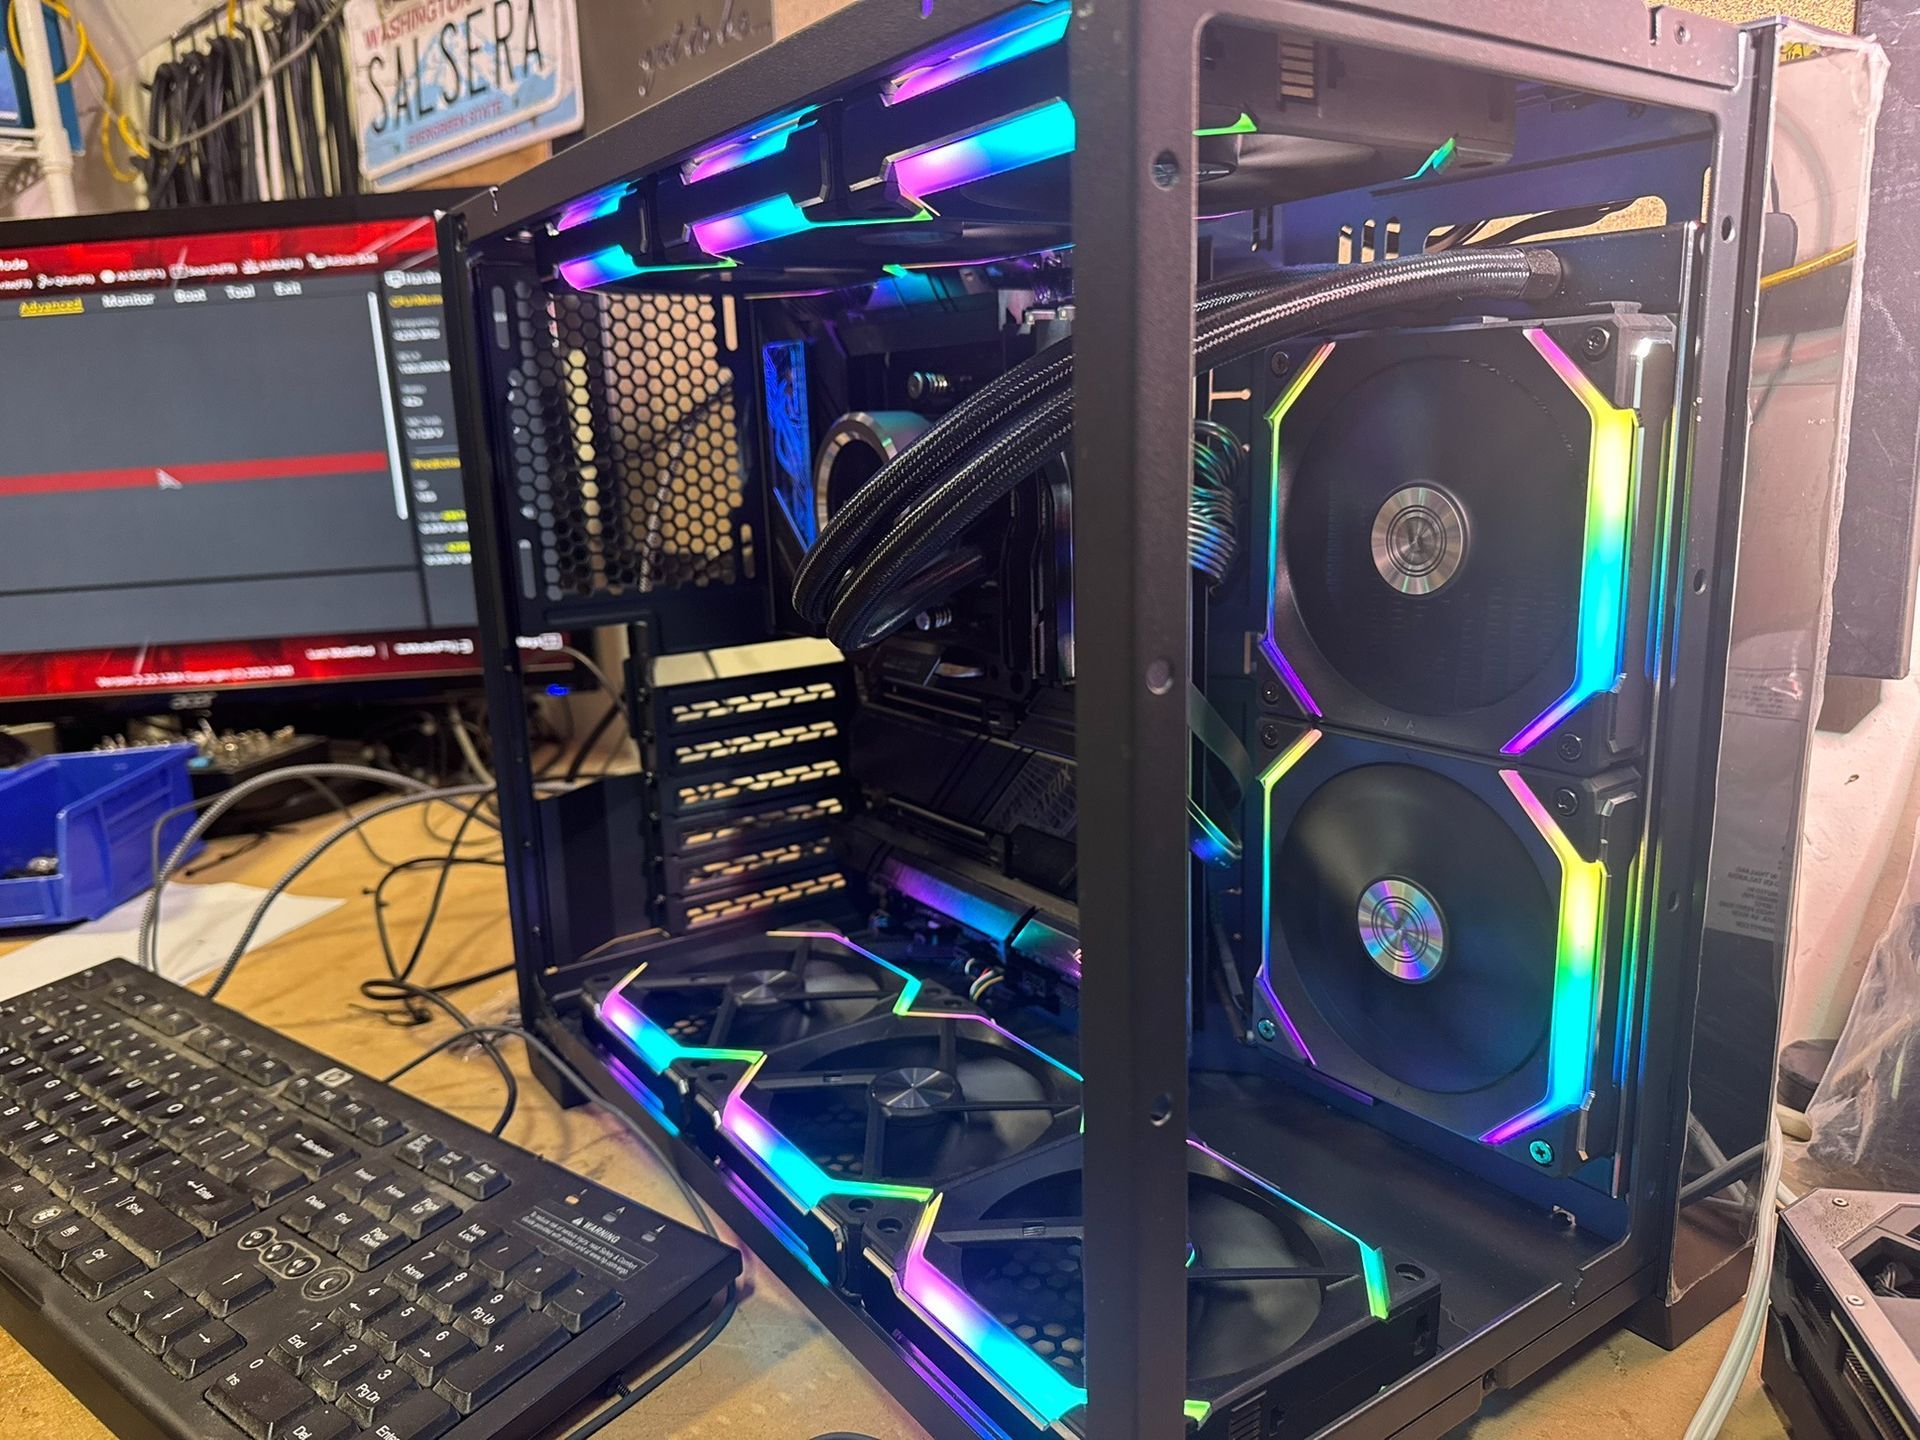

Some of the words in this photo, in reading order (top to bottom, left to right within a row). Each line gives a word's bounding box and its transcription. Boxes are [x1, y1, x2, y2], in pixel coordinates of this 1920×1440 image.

[20, 297, 83, 314] Advanced
[102, 292, 155, 308] Monitor
[224, 284, 256, 299] Tool
[88, 1055, 105, 1065] T
[108, 1066, 123, 1077] Y
[44, 1079, 61, 1089] G
[126, 1078, 144, 1089] U
[63, 1091, 81, 1101] H
[3, 1106, 20, 1116] B
[81, 1104, 97, 1112] J
[166, 1103, 184, 1113] O
[22, 1120, 40, 1131] N
[100, 1115, 119, 1127] K
[188, 1115, 206, 1125] P
[40, 1133, 60, 1144] M
[121, 1129, 137, 1140] L
[384, 1184, 406, 1199] Home
[334, 1212, 353, 1225] End
[468, 1223, 488, 1237] Num
[582, 1220, 622, 1244] WARNING
[420, 1251, 436, 1261] 7
[401, 1263, 425, 1280] Home
[454, 1272, 468, 1282] 8
[368, 1286, 381, 1297] 4
[490, 1294, 504, 1304] 9
[400, 1306, 416, 1317] 5
[471, 1306, 485, 1320] Pg
[482, 1313, 497, 1326] Up
[310, 1322, 323, 1331] 1
[435, 1330, 450, 1341] 6
[287, 1334, 307, 1349] End
[342, 1344, 358, 1355] 2
[249, 1358, 264, 1369] 0
[225, 1372, 241, 1386] Ins
[377, 1369, 392, 1380] 3
[355, 1383, 370, 1398] Pg
[366, 1389, 381, 1404] Dn
[292, 1425, 313, 1440] Del
[375, 1425, 400, 1440] Ente
